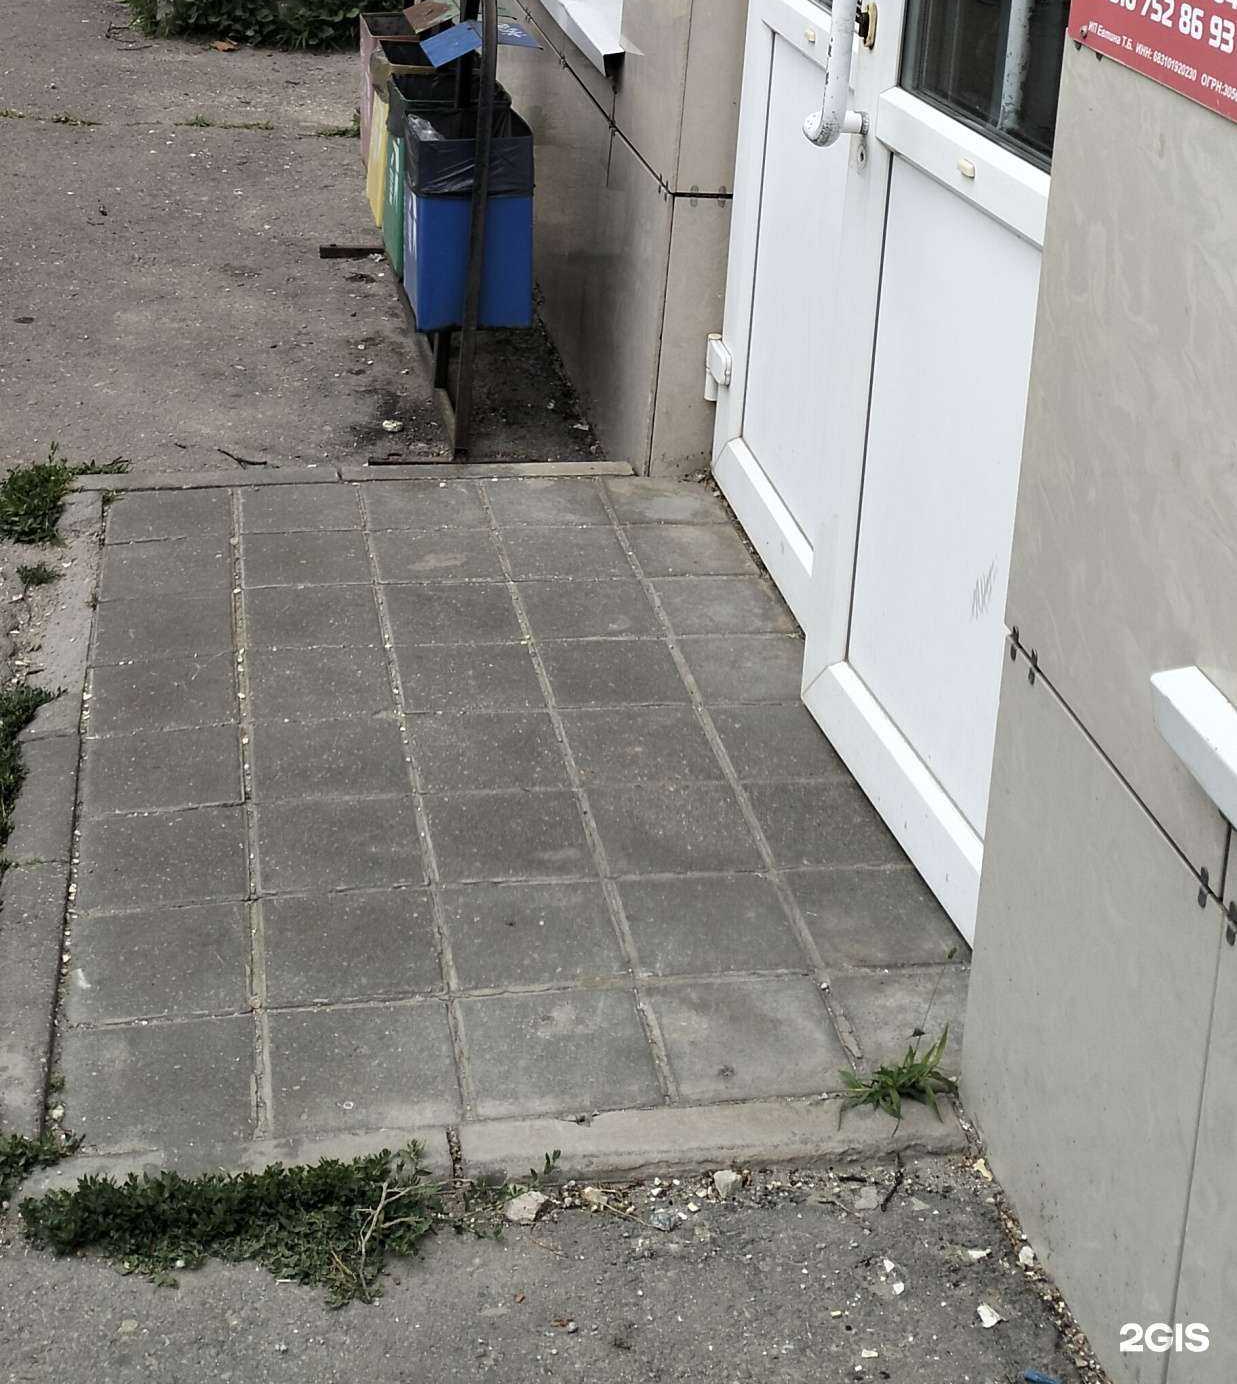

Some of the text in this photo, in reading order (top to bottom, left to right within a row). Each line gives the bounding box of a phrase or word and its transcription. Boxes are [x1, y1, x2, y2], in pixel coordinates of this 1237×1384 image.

[1088, 20, 1098, 34] ИП
[1135, 43, 1153, 61] ИНН:
[1178, 2, 1205, 40] 86
[1208, 14, 1236, 54] 93
